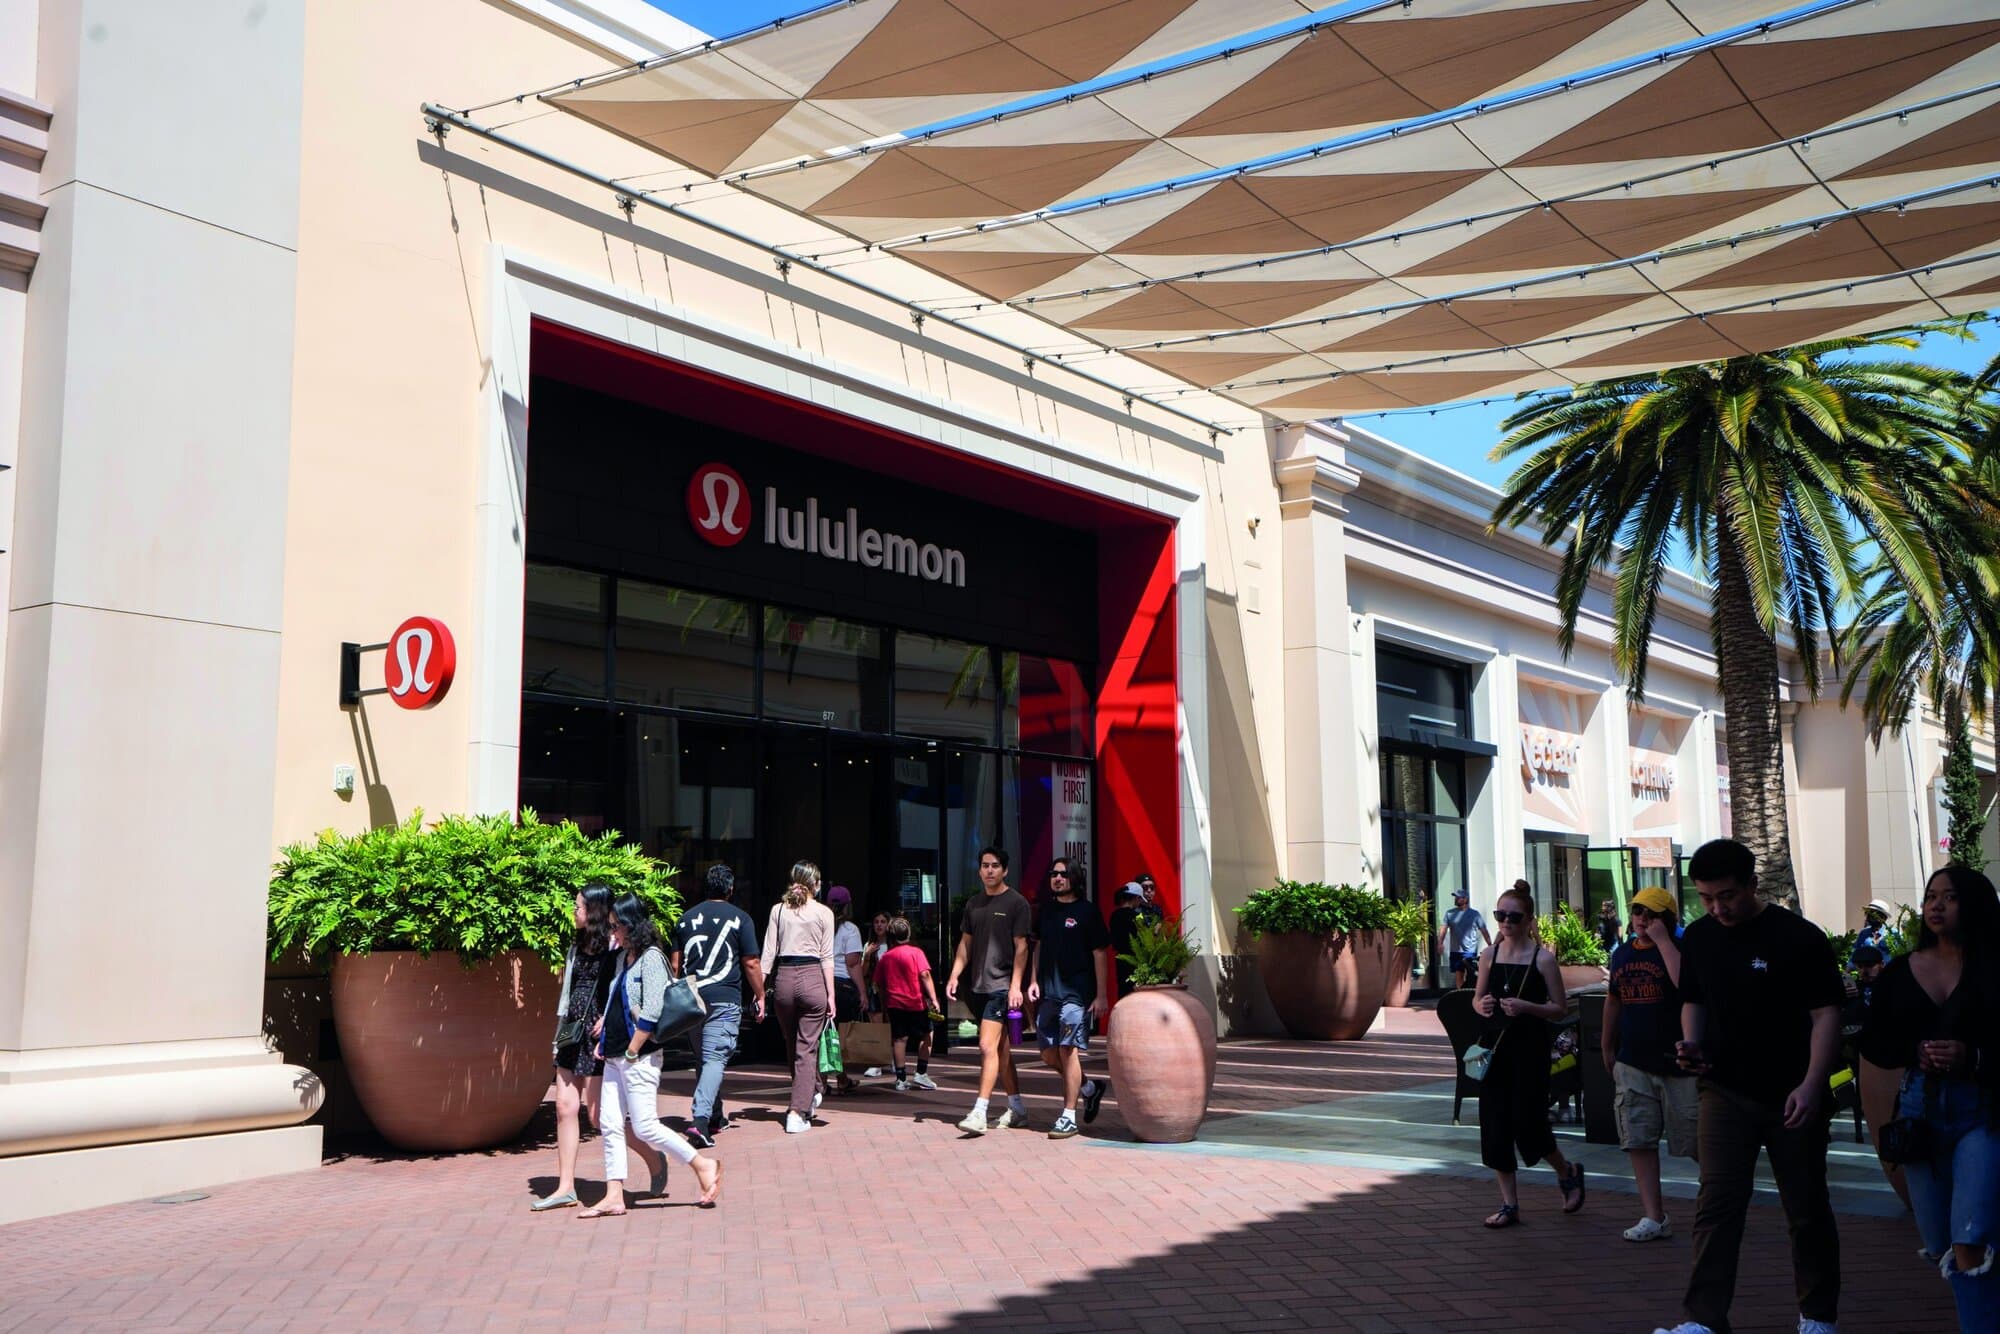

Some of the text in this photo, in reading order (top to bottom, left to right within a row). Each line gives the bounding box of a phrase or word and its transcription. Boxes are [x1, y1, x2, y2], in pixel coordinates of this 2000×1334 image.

[764, 486, 966, 587] lululemon
[1063, 780, 1088, 805] FIRST.
[1064, 841, 1088, 865] MADE
